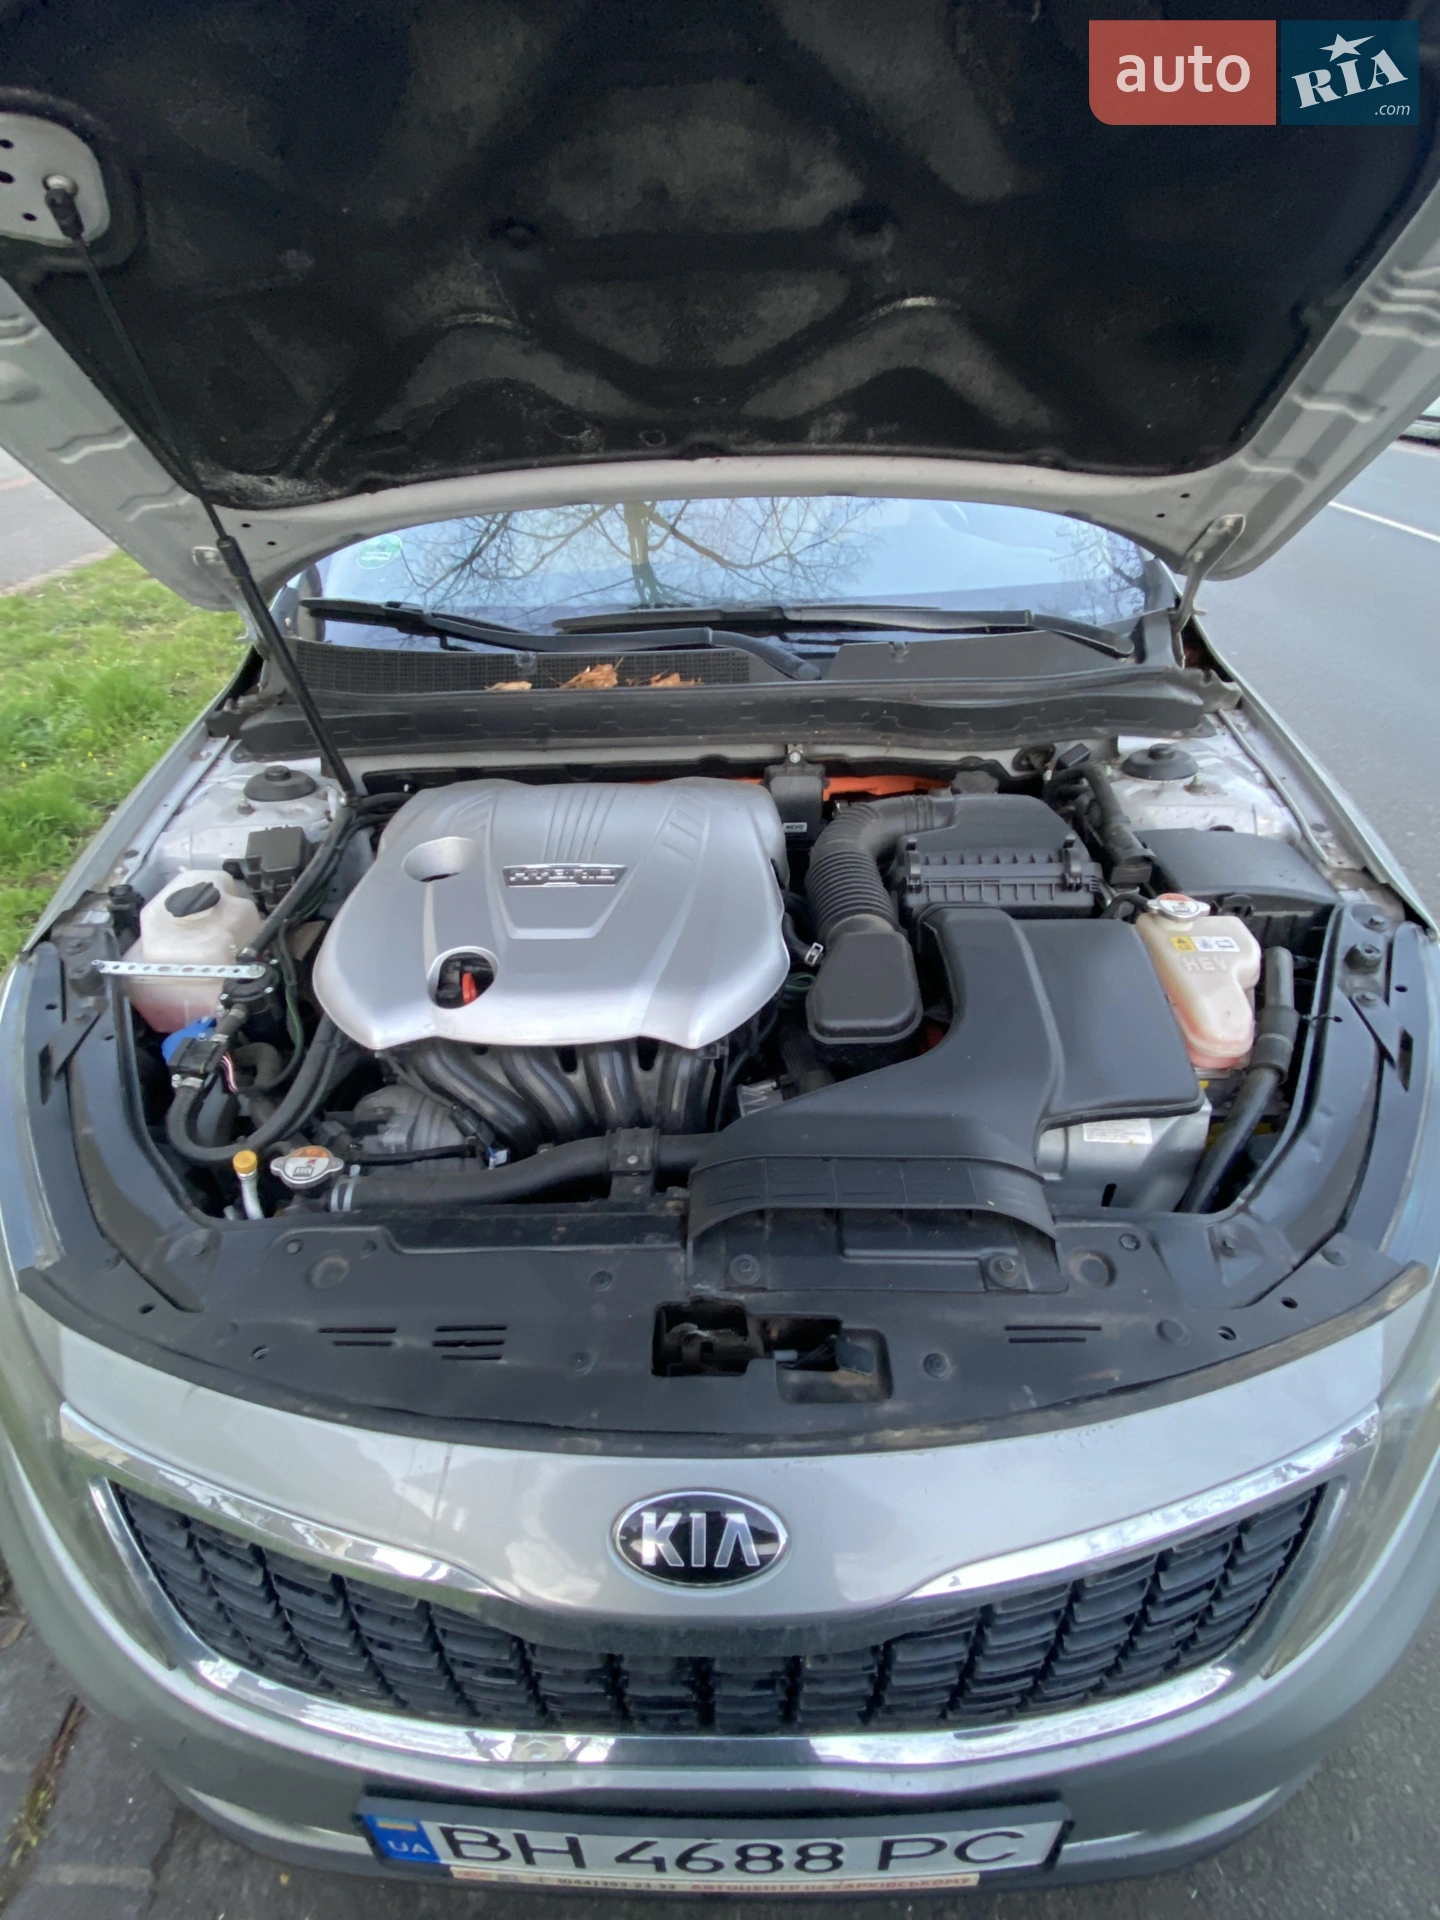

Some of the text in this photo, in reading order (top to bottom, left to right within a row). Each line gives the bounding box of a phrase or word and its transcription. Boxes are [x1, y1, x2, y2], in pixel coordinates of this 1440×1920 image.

[1181, 955, 1228, 972] HEV
[640, 1511, 761, 1568] KIA
[387, 1840, 431, 1856] UA
[439, 1826, 1027, 1875] BH 4688 PC
